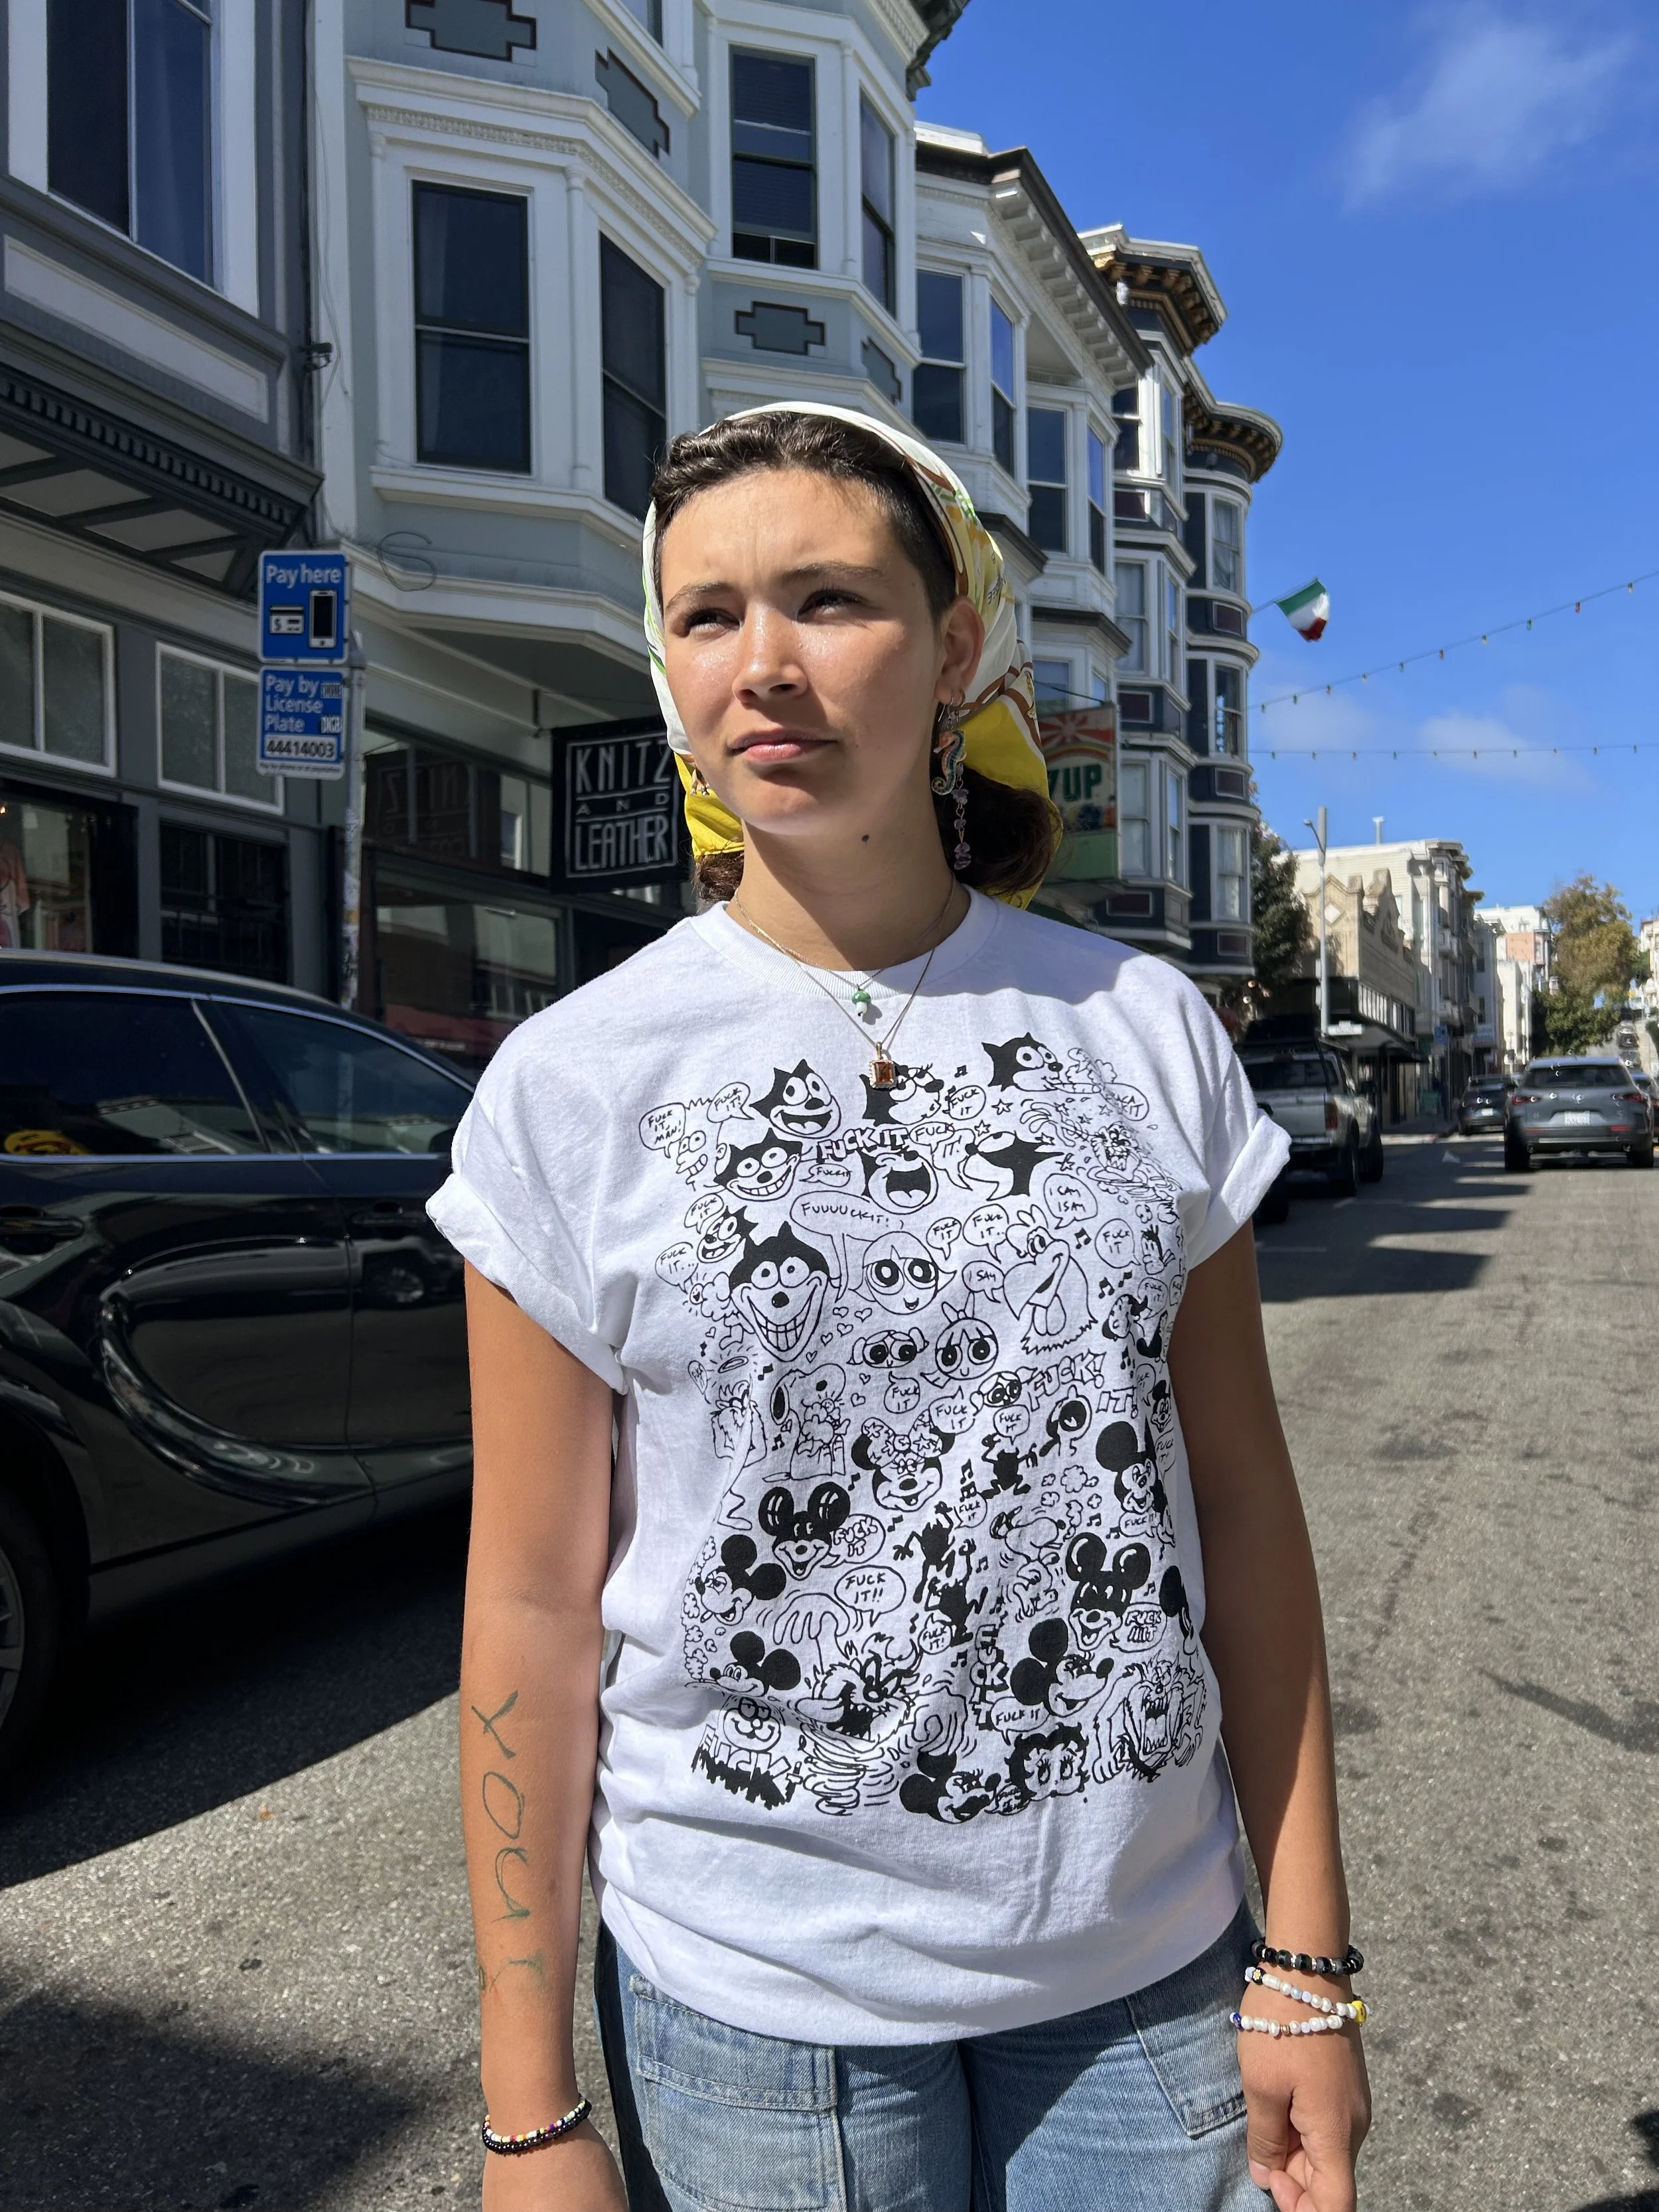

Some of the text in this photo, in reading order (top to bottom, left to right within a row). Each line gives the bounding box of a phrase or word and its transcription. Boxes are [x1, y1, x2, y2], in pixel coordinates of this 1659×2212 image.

[266, 563, 342, 589] Pay here
[266, 674, 297, 697] Pay
[298, 674, 320, 698] by
[266, 694, 324, 714] License
[265, 713, 305, 732] Plate
[265, 739, 334, 759] 44414003
[575, 739, 672, 794] KNITZ
[576, 792, 670, 815] AND
[575, 814, 669, 871] LEATHER
[714, 1088, 742, 1111] FUCK
[949, 1088, 979, 1109] FUCK
[648, 1110, 673, 1128] FUCK
[960, 1106, 973, 1116] IT
[914, 1123, 954, 1142] FUCK
[816, 1127, 878, 1163] FUCK
[690, 1197, 717, 1216] FUCK
[700, 1207, 711, 1219] IT
[932, 1220, 958, 1236] FUCK
[972, 1214, 1003, 1227] FUCK
[941, 1229, 953, 1240] IT
[1103, 1229, 1131, 1242] FUCK
[660, 1247, 687, 1265] FUCK
[1109, 1241, 1122, 1254] IT
[892, 1386, 920, 1398] FUCK
[897, 1399, 910, 1411] IT
[935, 1405, 968, 1418] FUCK
[952, 1418, 966, 1430] IT
[999, 1413, 1022, 1423] FUCK
[959, 1501, 981, 1513] FUCK
[833, 1516, 878, 1545] FUCK
[1125, 1516, 1147, 1528] FUCK
[848, 1538, 866, 1557] IT
[845, 1572, 886, 1589] FUCK
[922, 1625, 947, 1641] FUCK
[995, 1708, 1041, 1726] FUCK IT
